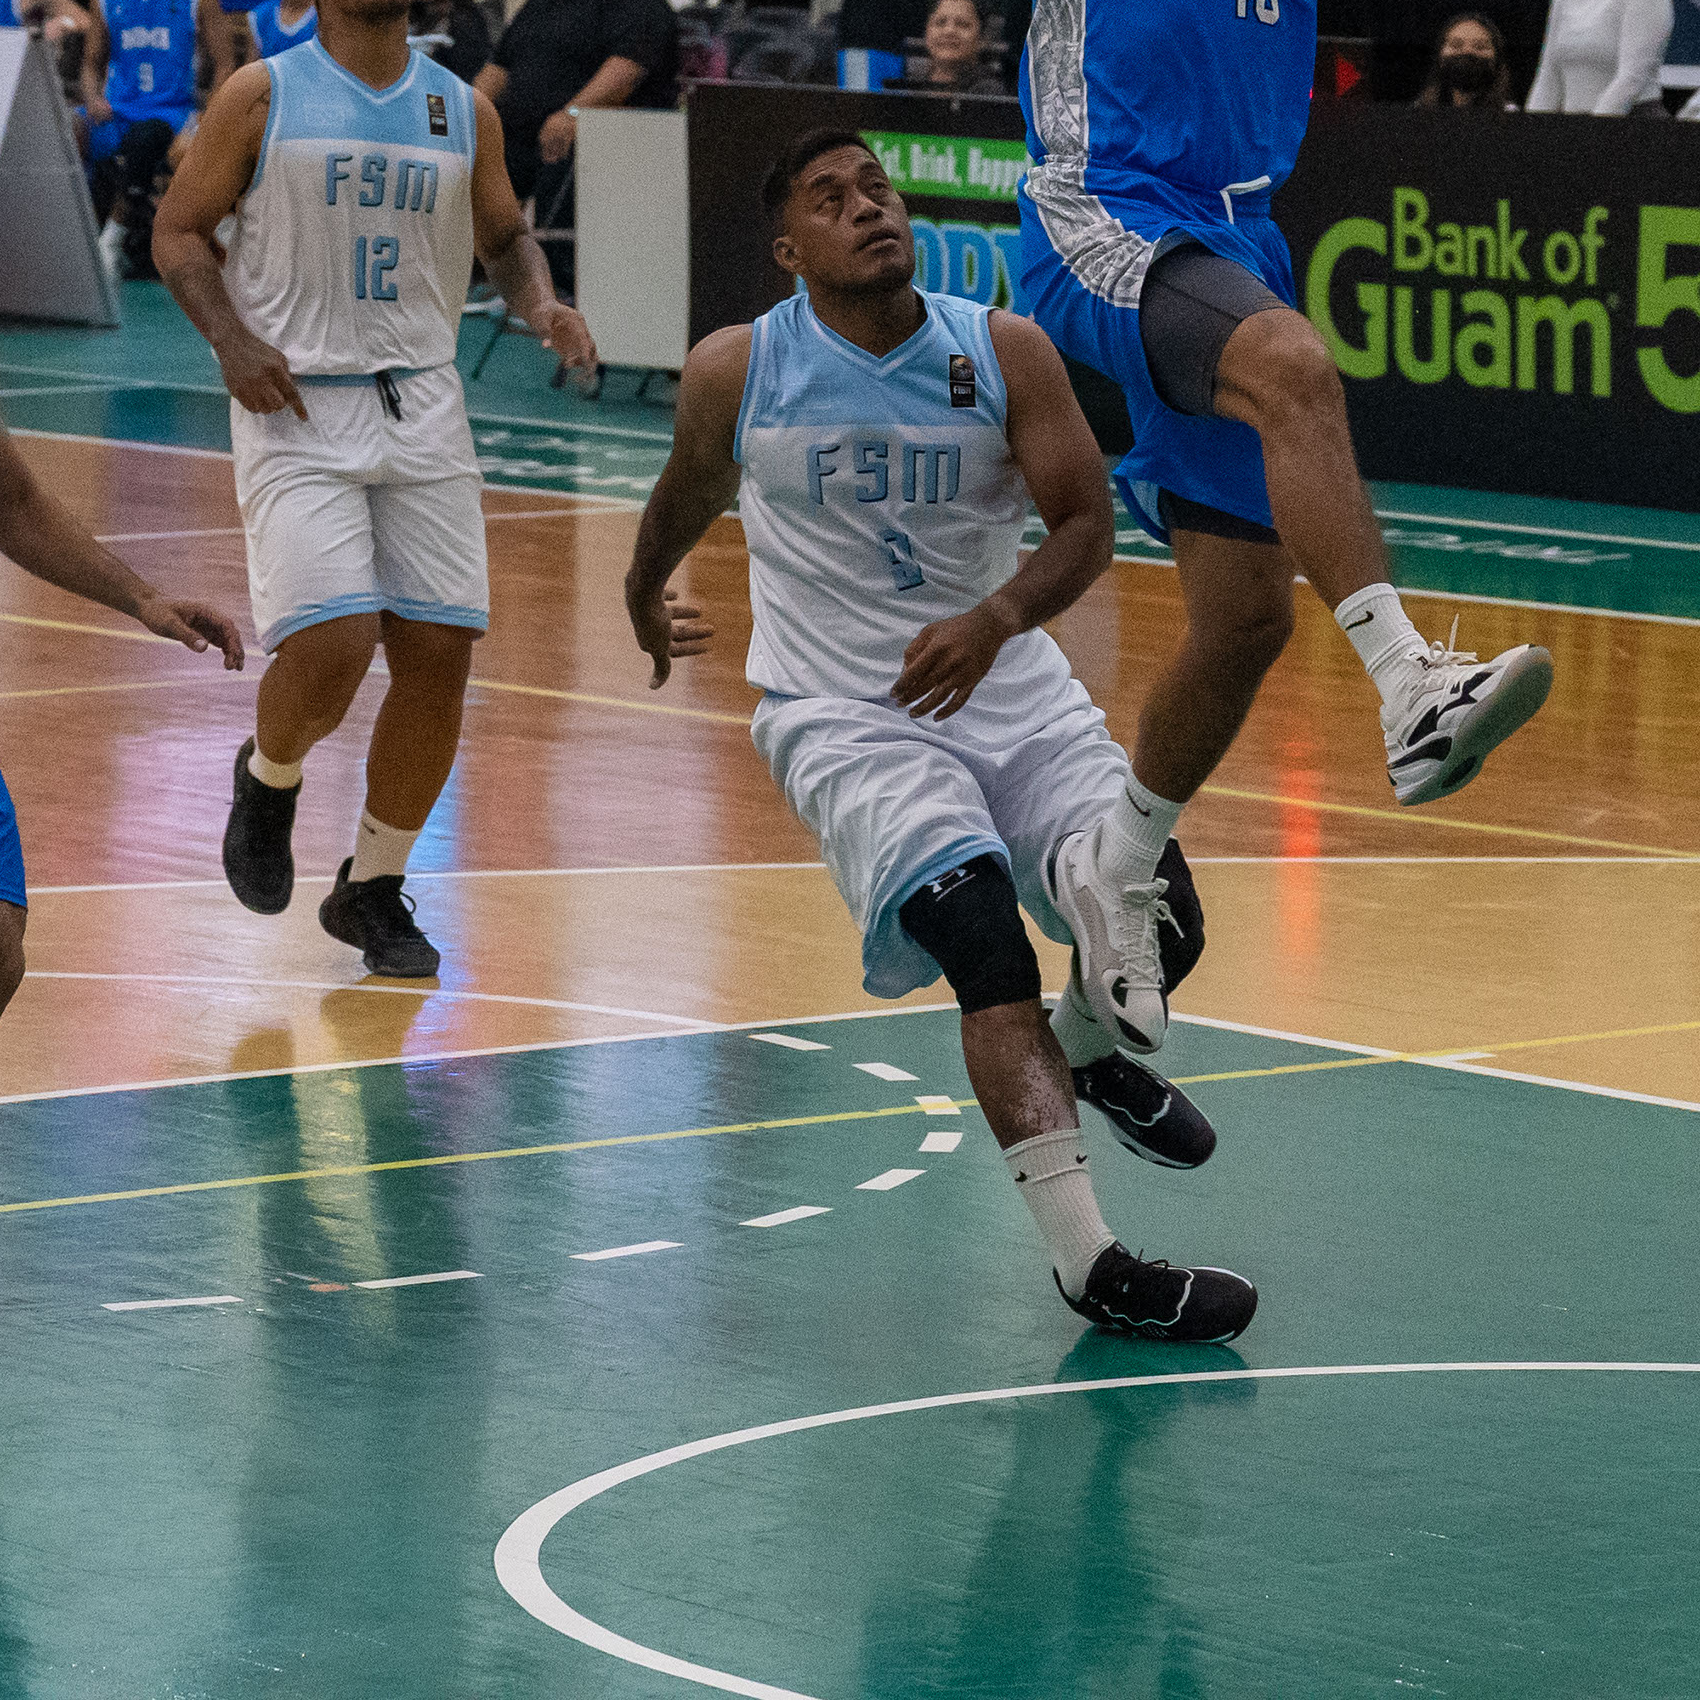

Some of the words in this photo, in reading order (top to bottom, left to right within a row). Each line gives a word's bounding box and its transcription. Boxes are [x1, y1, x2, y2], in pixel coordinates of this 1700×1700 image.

[325, 152, 438, 214] FSM
[355, 235, 400, 301] 12
[1393, 186, 1531, 281] Bank
[1543, 205, 1610, 286] of
[1305, 216, 1613, 398] Guam
[806, 440, 961, 510] FSM
